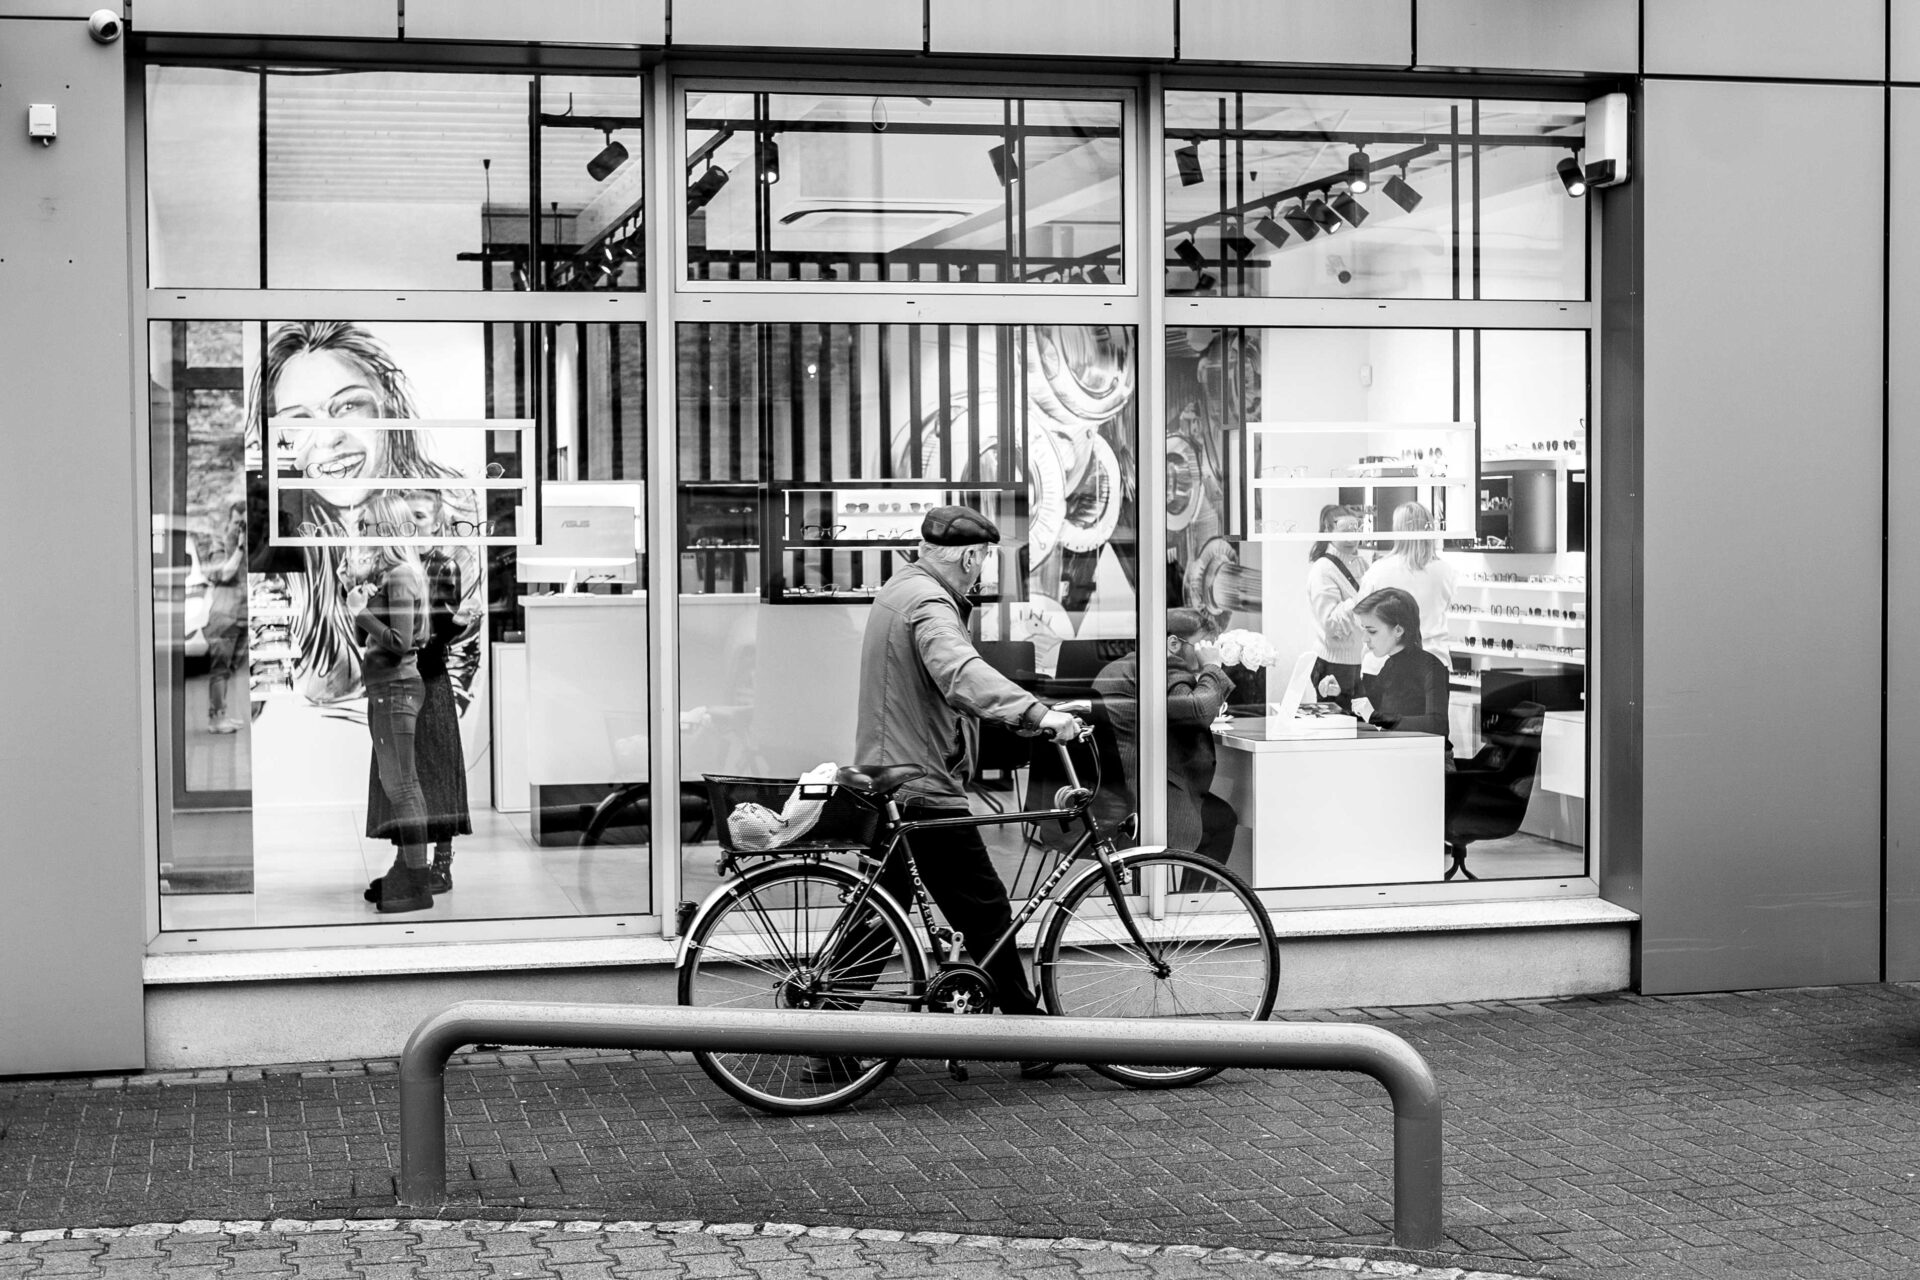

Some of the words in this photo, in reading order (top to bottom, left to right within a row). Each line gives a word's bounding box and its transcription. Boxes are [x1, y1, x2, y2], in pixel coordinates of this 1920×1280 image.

[561, 520, 590, 528] ASUS
[907, 857, 922, 886] TWO
[921, 902, 938, 935] ZERO
[1029, 860, 1070, 909] DELTA
